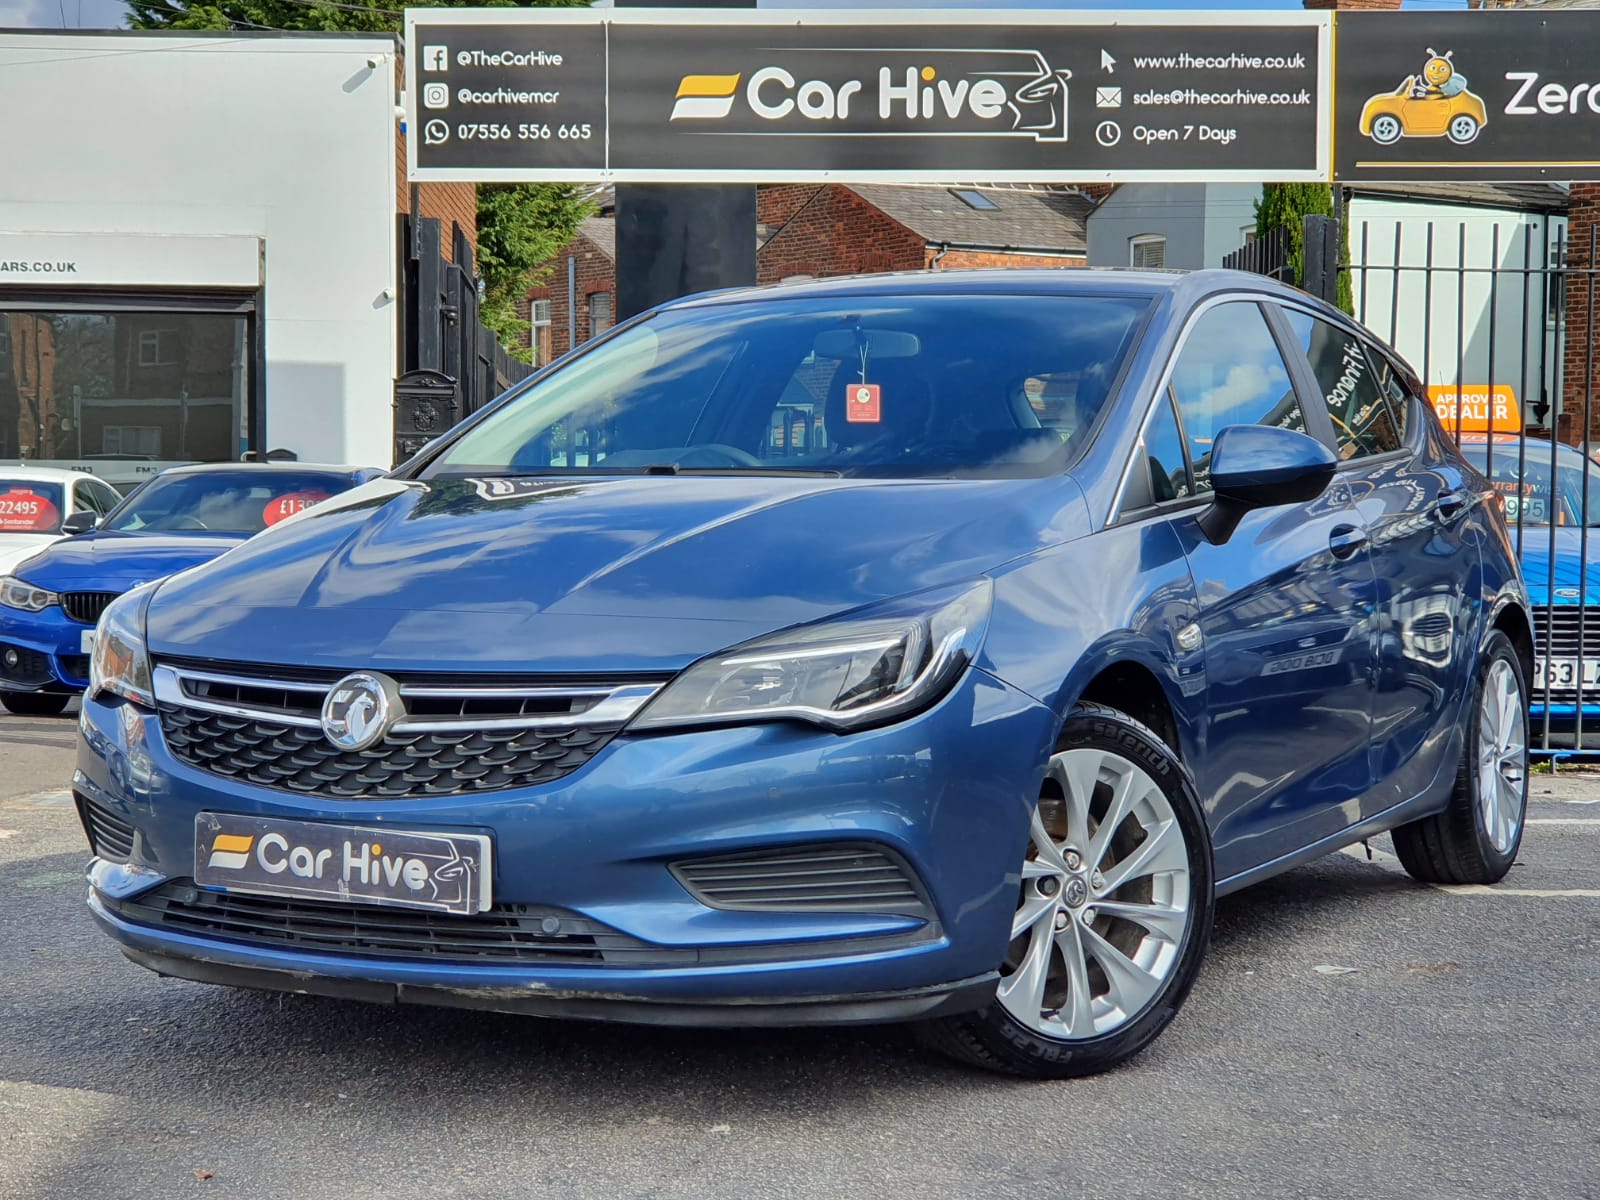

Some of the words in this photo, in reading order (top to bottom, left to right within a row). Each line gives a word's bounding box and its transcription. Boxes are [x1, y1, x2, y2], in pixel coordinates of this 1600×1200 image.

[457, 50, 563, 67] @TheCarHive
[1133, 52, 1305, 69] www.thecarhive.co.uk
[457, 87, 560, 105] @carhivemcr
[746, 66, 862, 120] Car
[878, 66, 1008, 120] Hive
[1133, 88, 1311, 105] sales@thecarhive.co.uk
[458, 124, 512, 140] 07556
[517, 124, 552, 140] 556
[557, 124, 592, 140] 665
[1132, 125, 1179, 145] Open
[1183, 125, 1194, 140] 7
[1199, 125, 1237, 145] Days
[256, 833, 332, 880] Car
[343, 840, 429, 891] Hive
